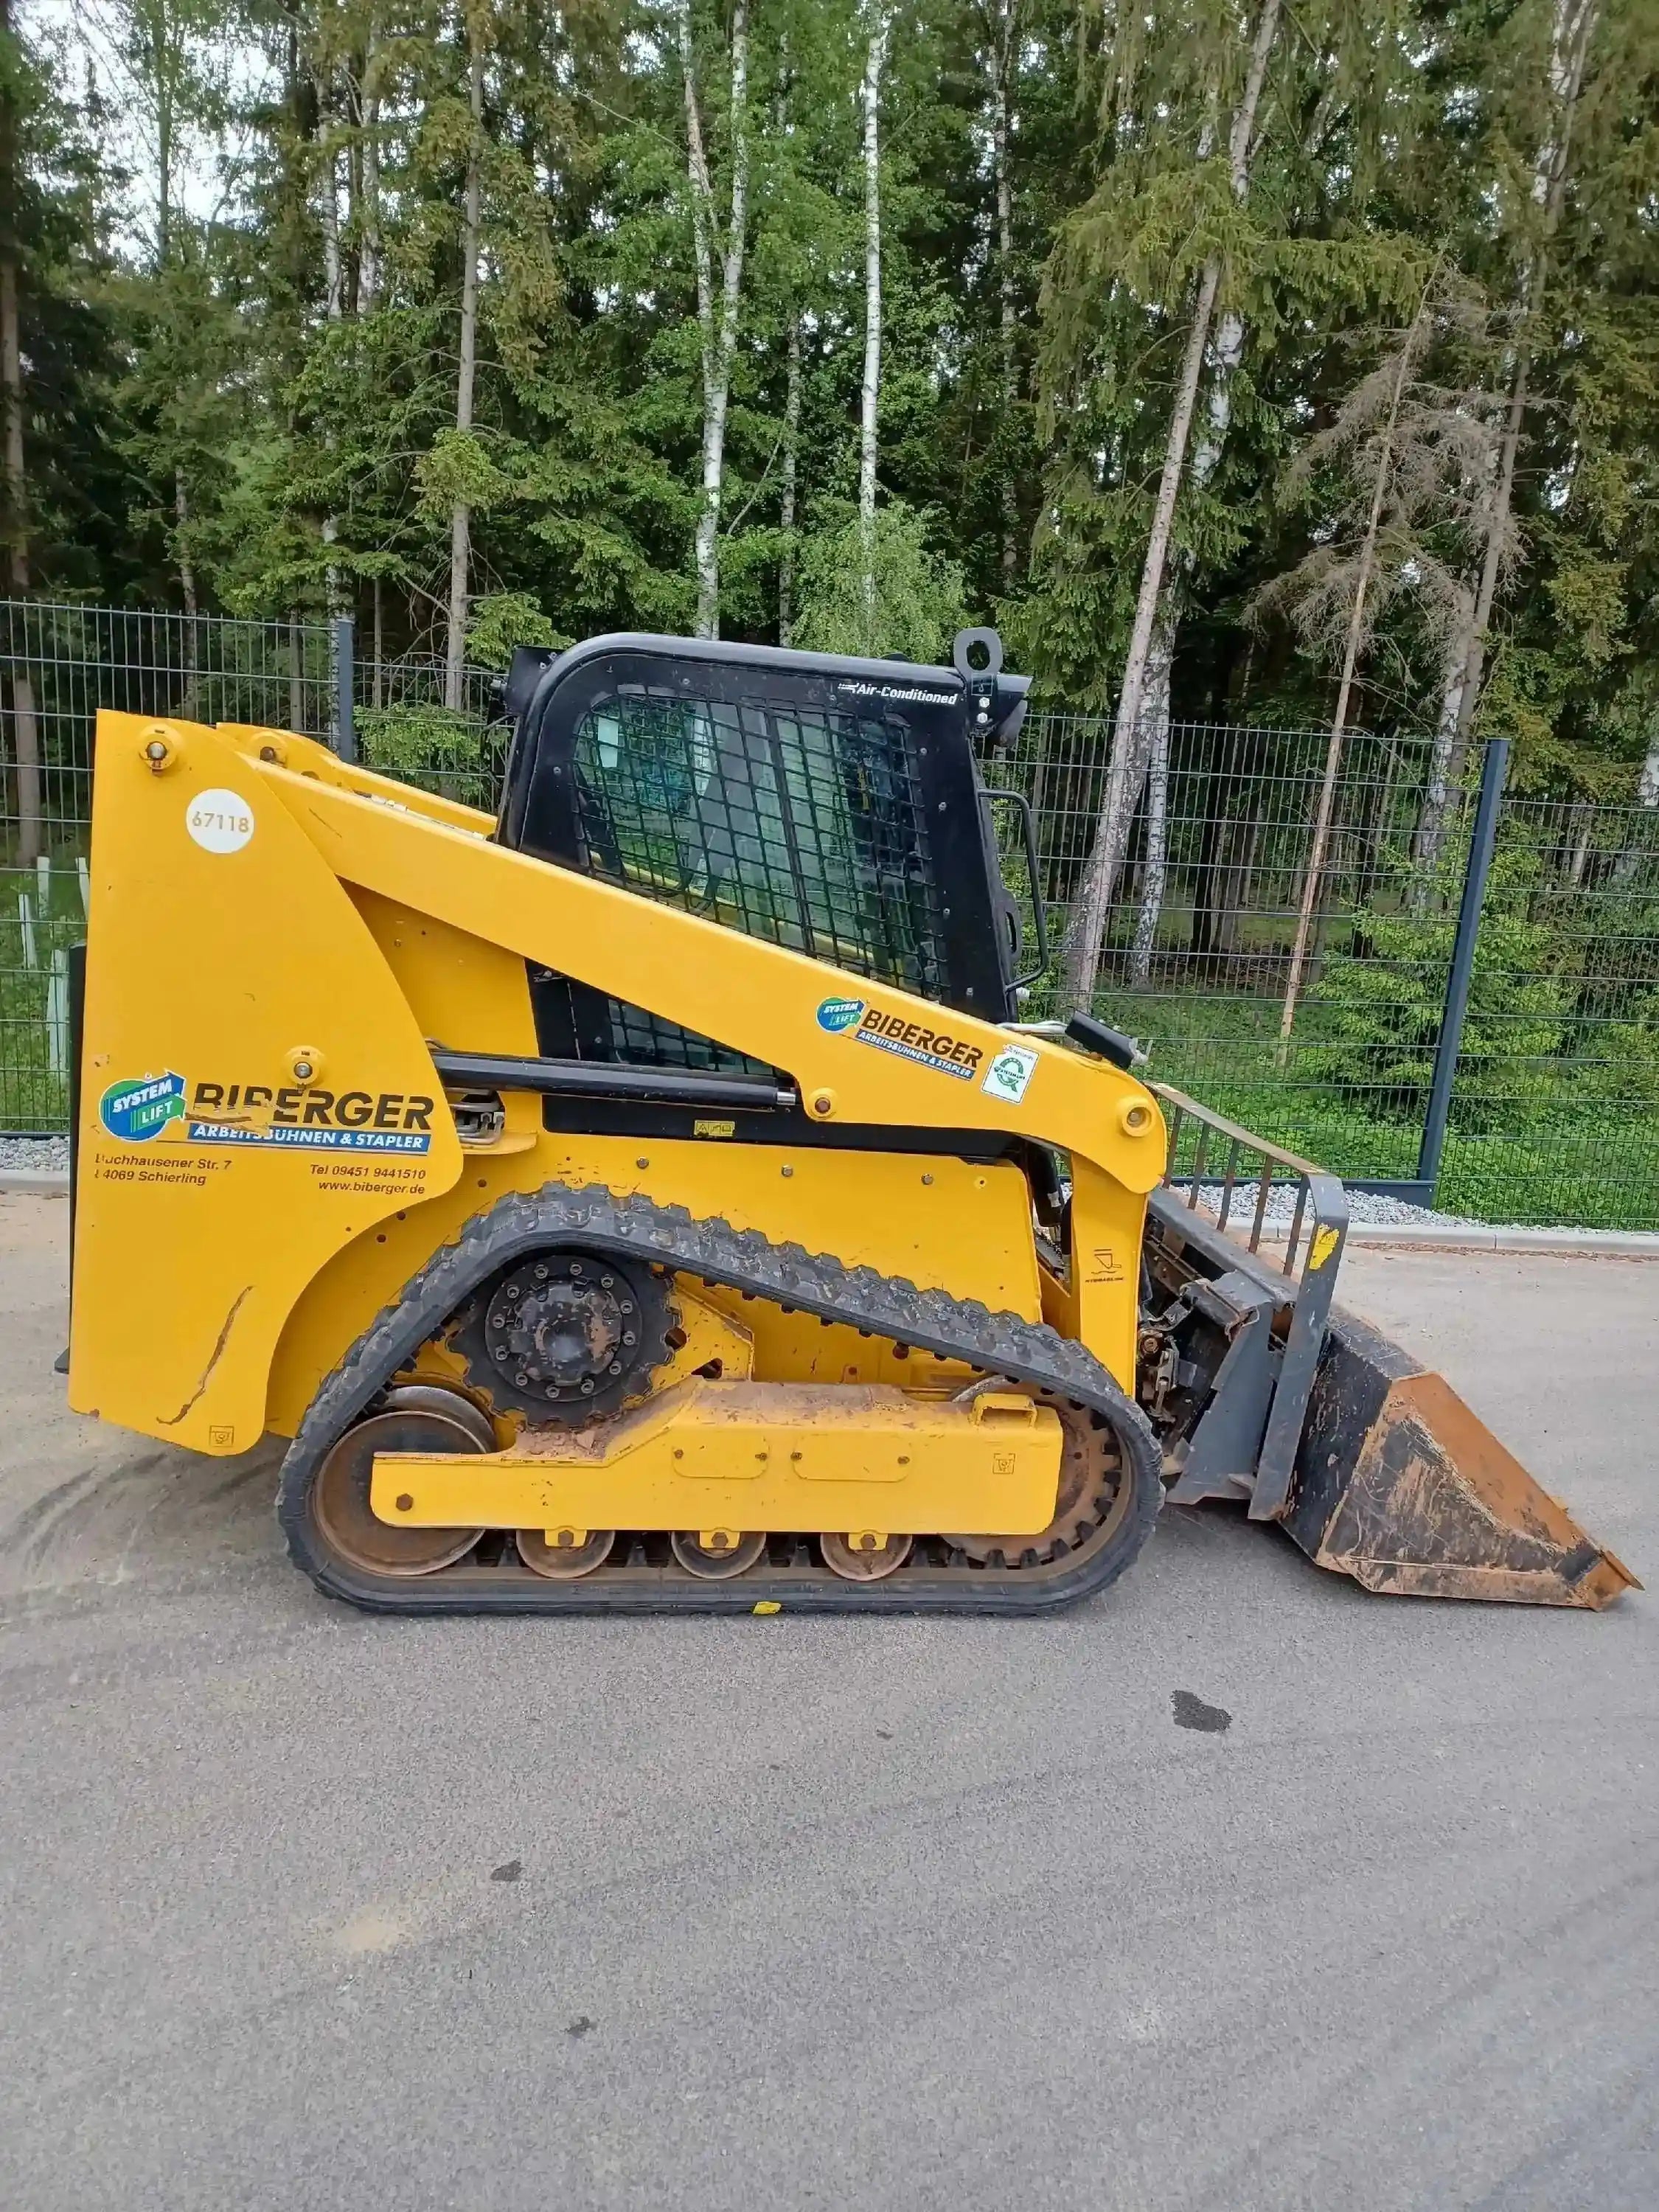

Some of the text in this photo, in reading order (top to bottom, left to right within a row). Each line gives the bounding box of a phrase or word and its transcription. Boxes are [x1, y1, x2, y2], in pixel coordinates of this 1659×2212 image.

[858, 685, 957, 704] Air-Conditioned
[192, 811, 249, 833] 67118
[823, 1002, 859, 1014] SYSTEM
[835, 1014, 855, 1023] LIFT
[861, 1009, 984, 1068] BIBERGER
[928, 1057, 938, 1066] &
[935, 1060, 973, 1078] STAPLER
[112, 1079, 173, 1113] SYSTEM
[141, 1101, 173, 1124] LIFT
[339, 1133, 352, 1146] &
[355, 1133, 424, 1149] STAPLER
[197, 1158, 220, 1170] Str.
[223, 1160, 232, 1170] 7
[310, 1164, 427, 1180] Tel 09451 9441510
[138, 1170, 207, 1186] Schierling
